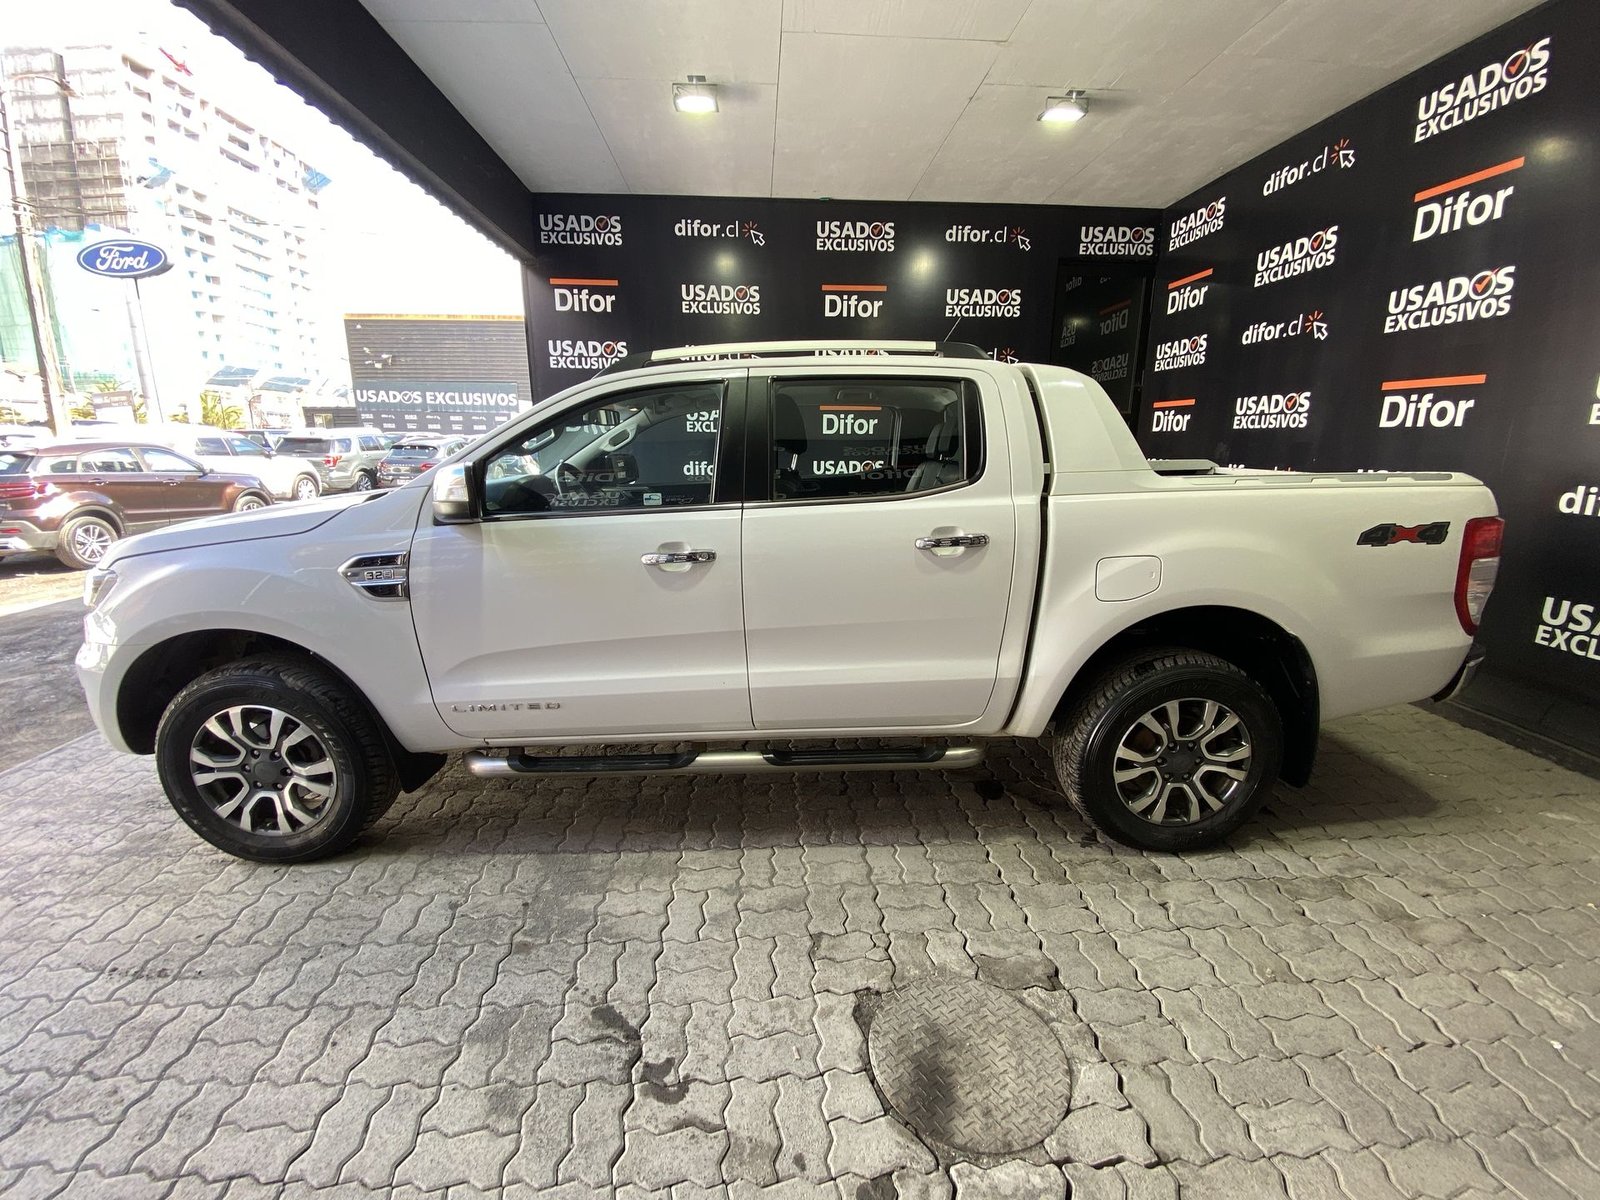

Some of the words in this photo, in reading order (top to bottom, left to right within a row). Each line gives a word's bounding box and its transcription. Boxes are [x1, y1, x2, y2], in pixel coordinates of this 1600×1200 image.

[1417, 36, 1551, 121] USADOS
[1414, 68, 1548, 143] EXCLUSIVOS
[1262, 146, 1329, 197] difor.cl
[539, 213, 622, 233] USADOS
[1170, 196, 1226, 238] USADOS
[1412, 186, 1515, 243] Difor
[540, 231, 623, 246] EXCLUSIVOS
[674, 219, 739, 238] difor.cl
[816, 220, 895, 240] USADOS
[945, 225, 1008, 243] difor.cl
[1080, 226, 1155, 244] USADOS
[1168, 215, 1224, 252] EXCLUSIVOS
[816, 238, 895, 252] EXCLUSIVOS
[1079, 243, 1154, 256] EXCLUSIVOS
[1256, 225, 1339, 273] USADOS
[95, 245, 149, 271] Ford
[1253, 248, 1336, 288] EXCLUSIVOS
[554, 288, 616, 313] Difor
[681, 283, 760, 303] USADOS
[946, 288, 1022, 306] USADOS
[1166, 285, 1209, 315] Difor
[1387, 265, 1516, 315] USADOS
[681, 300, 761, 315] EXCLUSIVOS
[824, 294, 883, 318] Difor
[945, 304, 1021, 318] EXCLUSIVOS
[1383, 294, 1512, 334] EXCLUSIVOS
[1241, 313, 1304, 346] difor.cl
[548, 339, 628, 358] USADOS
[1156, 333, 1208, 360] USADOS
[1154, 351, 1206, 373] EXCLUSIVOS
[356, 389, 422, 405] USADOS
[425, 391, 518, 407] EXCLUSIVOS
[1235, 391, 1312, 415] USADOS
[1151, 410, 1191, 433] Difor
[1232, 412, 1309, 430] EXCLUSIVOS
[1378, 393, 1475, 428] Difor
[822, 414, 879, 435] Difor
[451, 702, 561, 713] LIMITED
